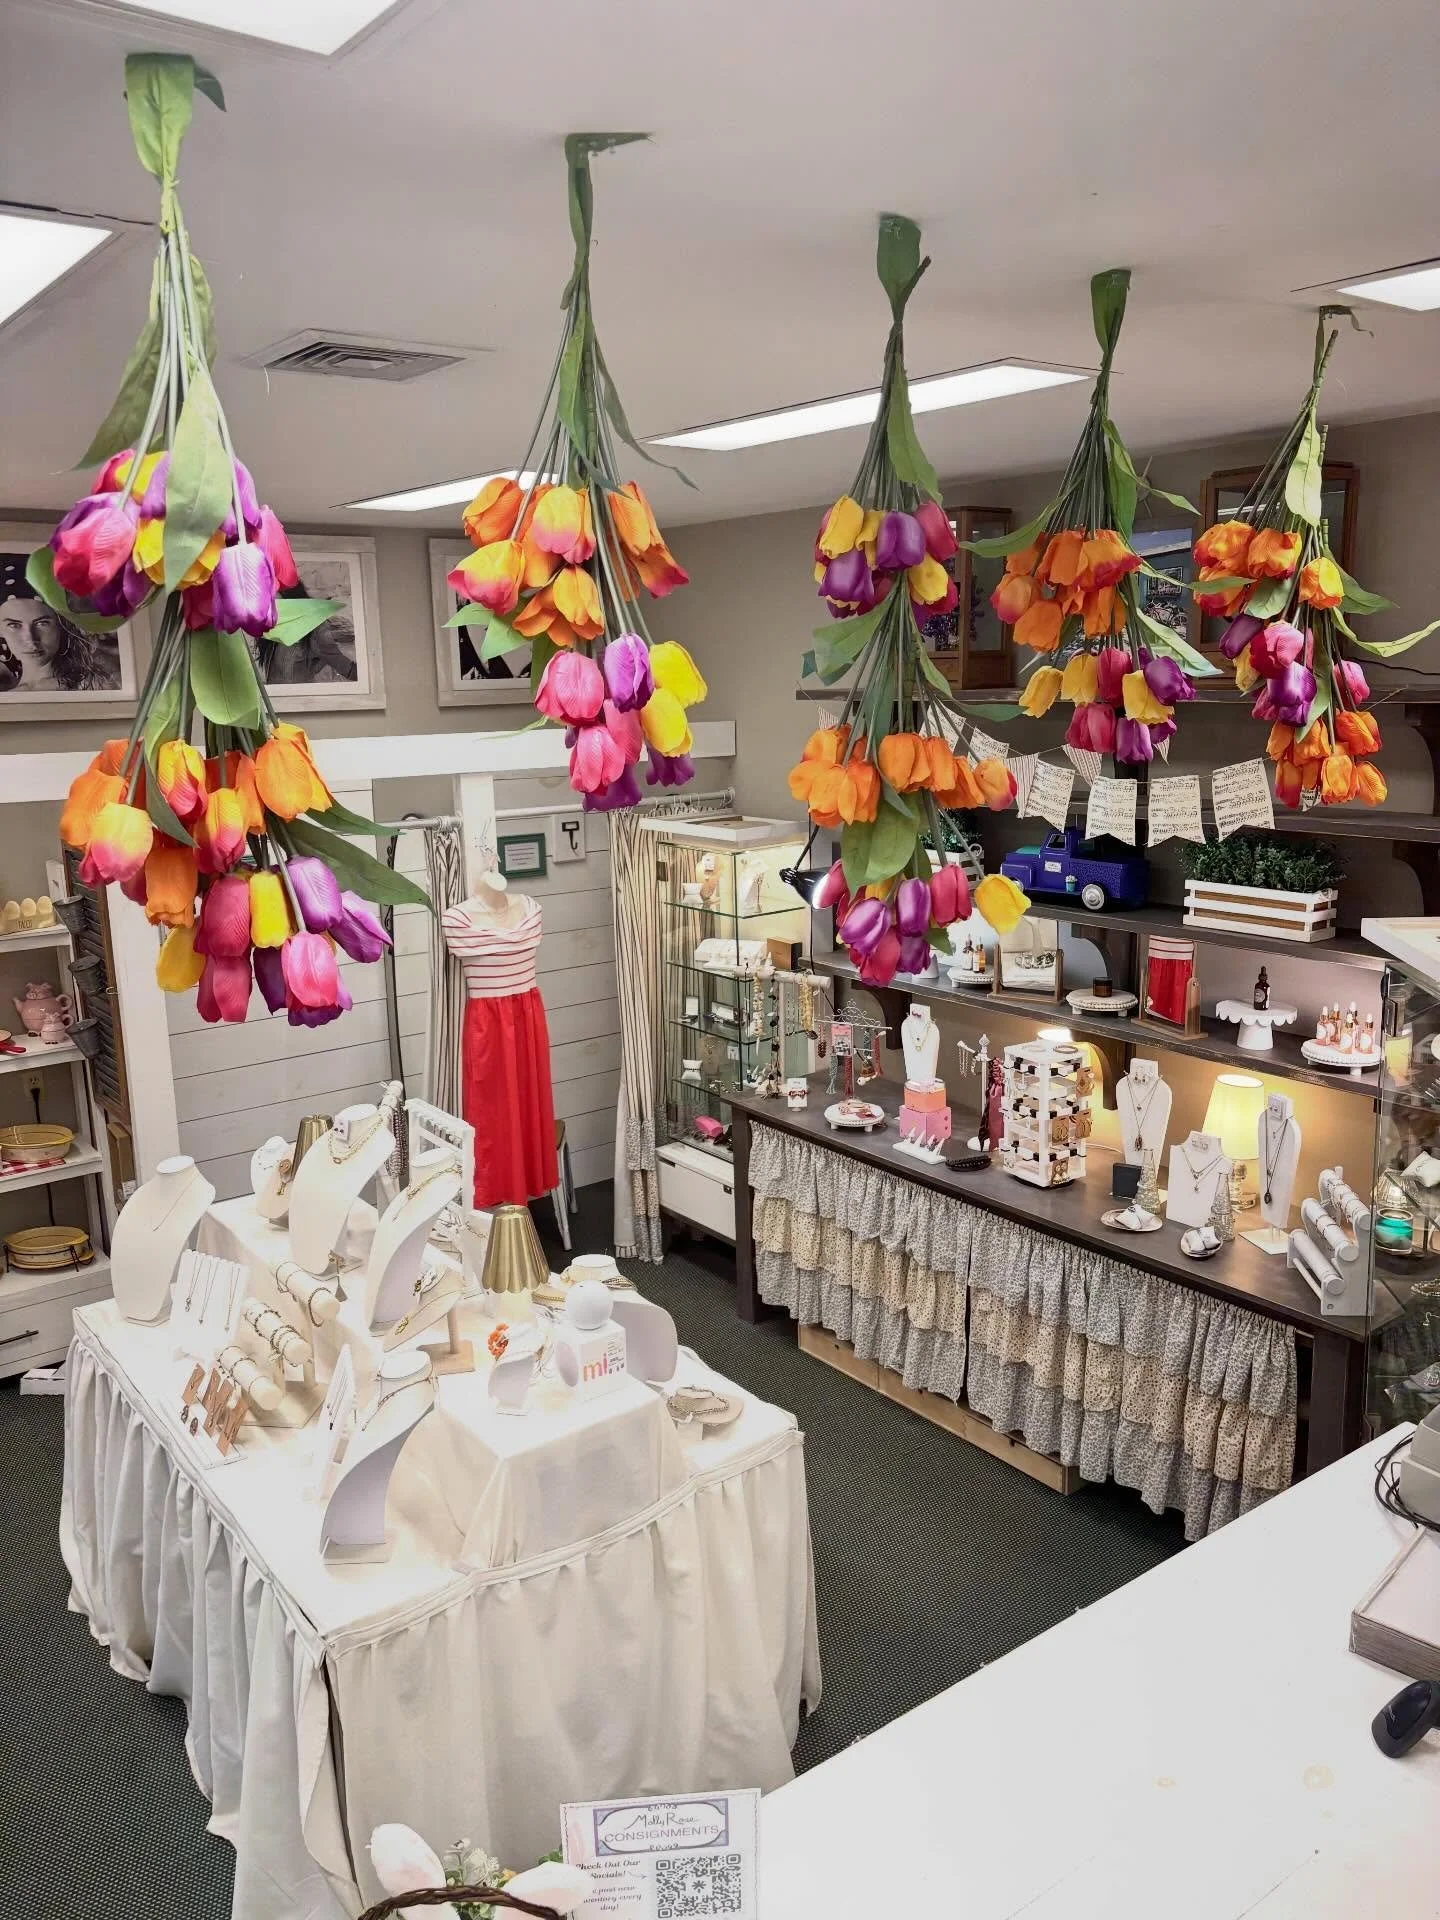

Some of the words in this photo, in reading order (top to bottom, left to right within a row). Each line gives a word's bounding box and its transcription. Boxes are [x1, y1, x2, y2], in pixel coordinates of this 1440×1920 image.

[624, 1814, 665, 1830] Molly
[666, 1812, 700, 1825] Rose
[604, 1825, 719, 1843] CONSIGNMENTS
